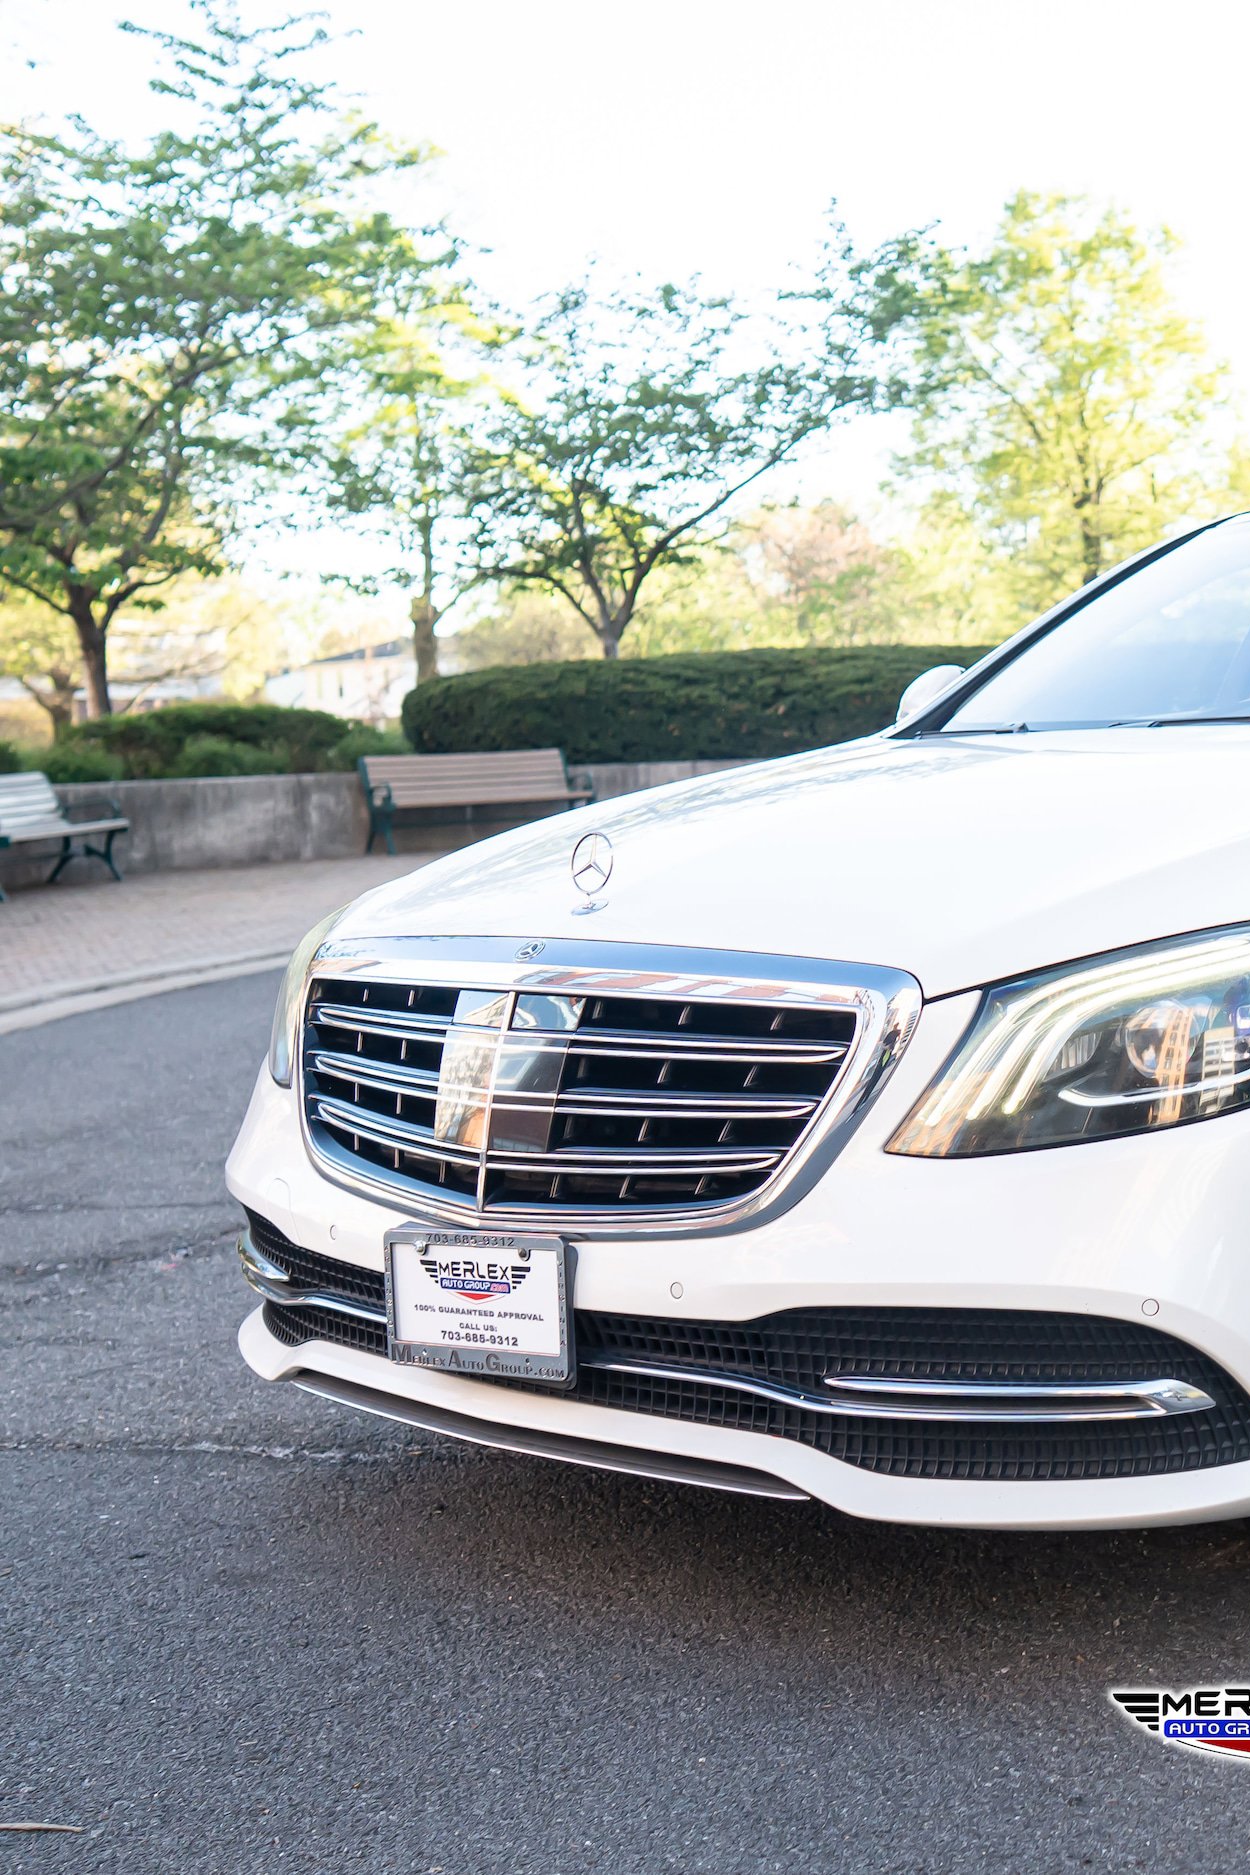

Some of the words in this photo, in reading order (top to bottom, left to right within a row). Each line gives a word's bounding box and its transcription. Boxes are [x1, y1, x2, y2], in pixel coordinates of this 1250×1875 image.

[425, 1233, 515, 1247] 703-685-9312
[438, 1261, 510, 1281] MERLEX
[441, 1278, 463, 1289] AUTO
[414, 1304, 436, 1313] 100%
[438, 1306, 495, 1318] GUARANTEED
[497, 1311, 544, 1321] APPROVAL
[459, 1322, 481, 1331] CALL
[483, 1324, 498, 1332] US:
[441, 1330, 518, 1346] 703-685-9312
